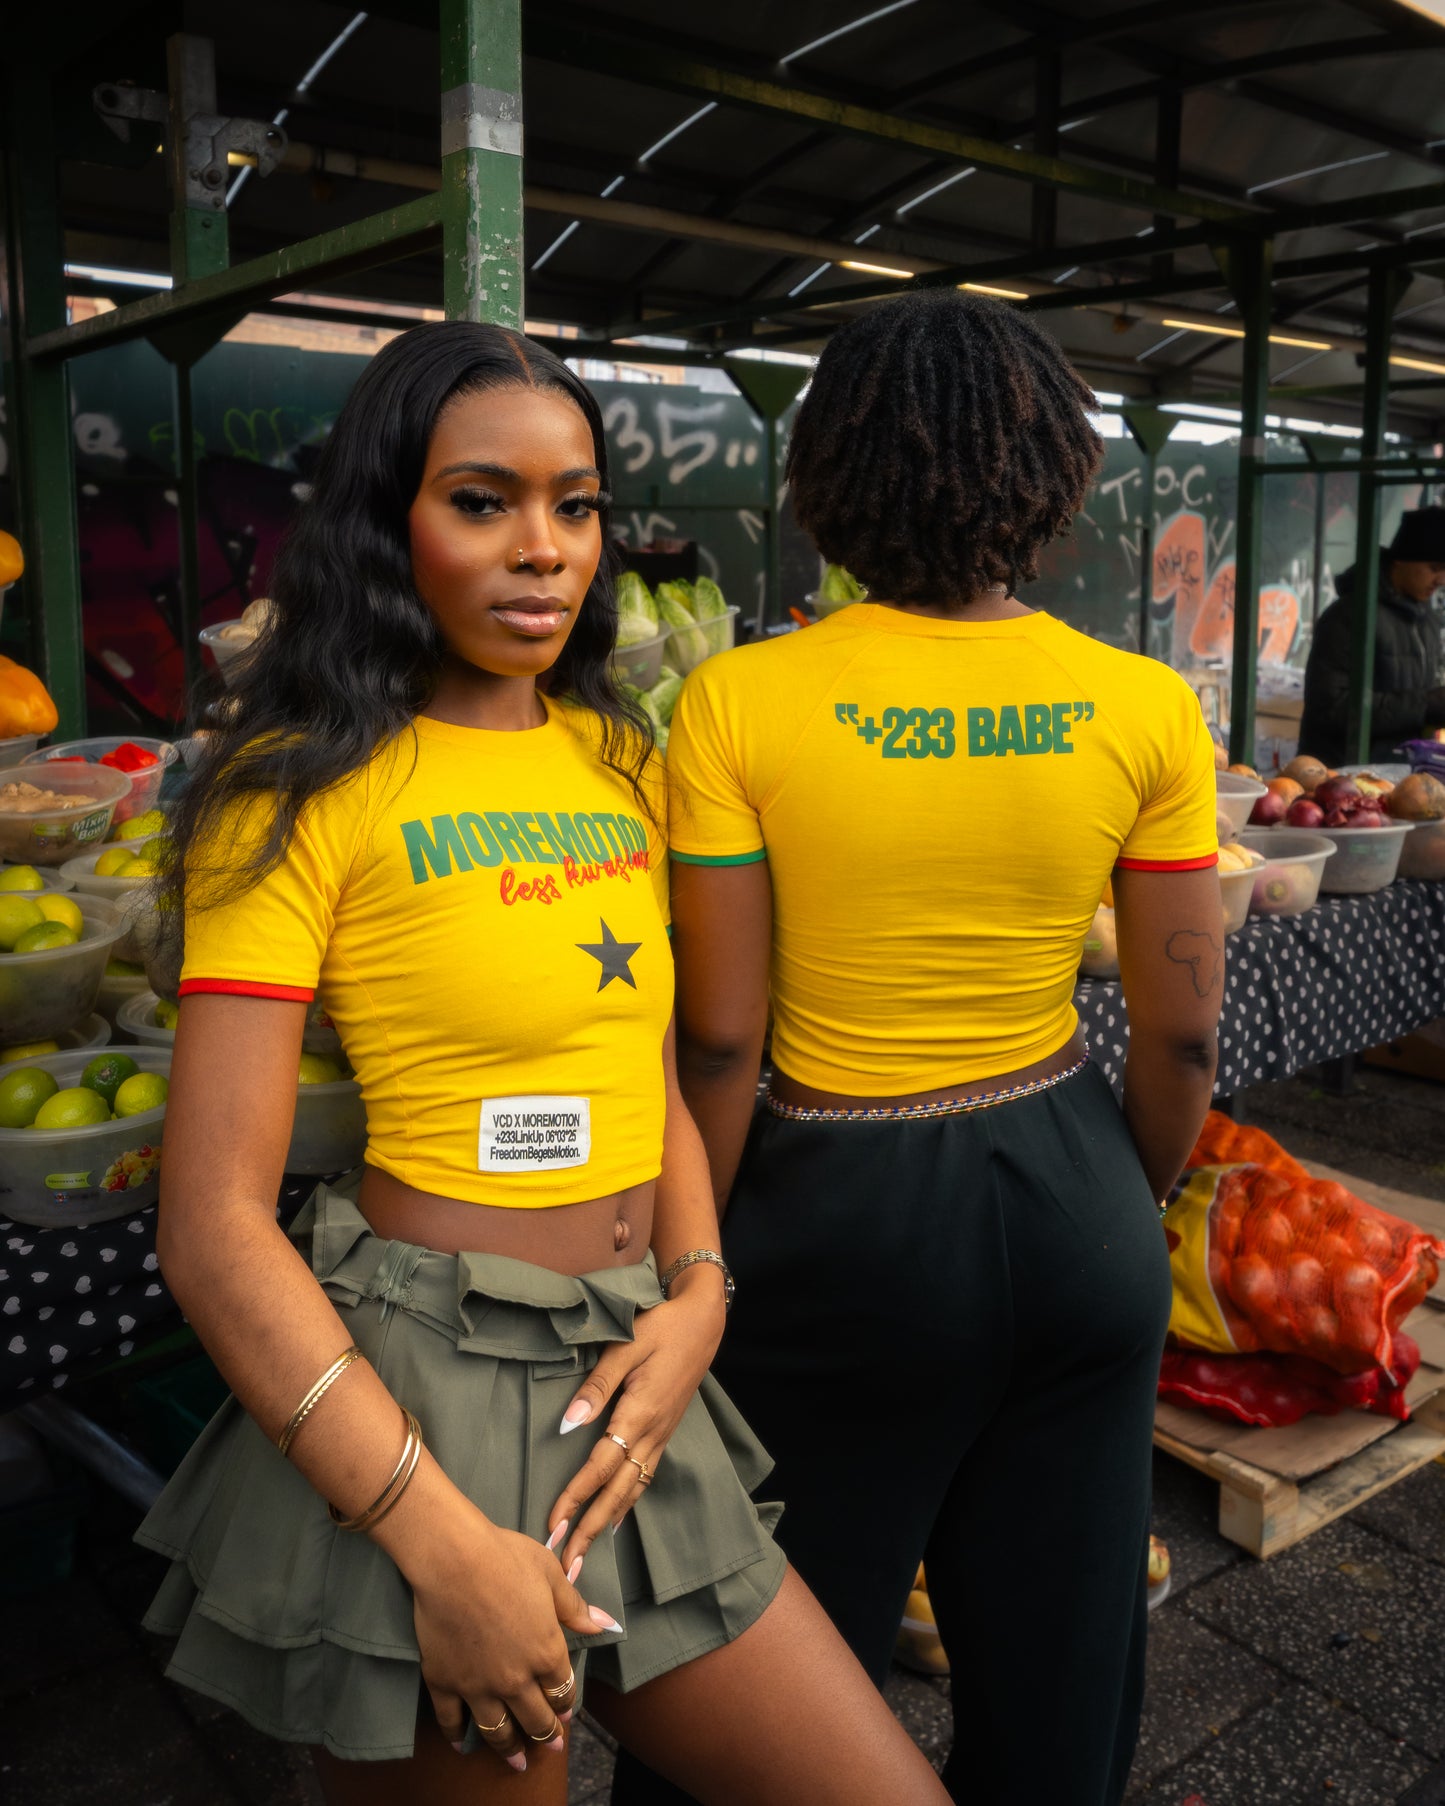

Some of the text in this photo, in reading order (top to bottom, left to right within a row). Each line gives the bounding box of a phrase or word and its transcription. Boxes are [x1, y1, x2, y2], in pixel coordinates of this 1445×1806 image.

[500, 869, 562, 906] less
[493, 1113, 581, 1129] VCD X MOREMOTION
[495, 1130, 544, 1147] +233LinkUp
[490, 1145, 580, 1163] FreedomBegetsMotion.
